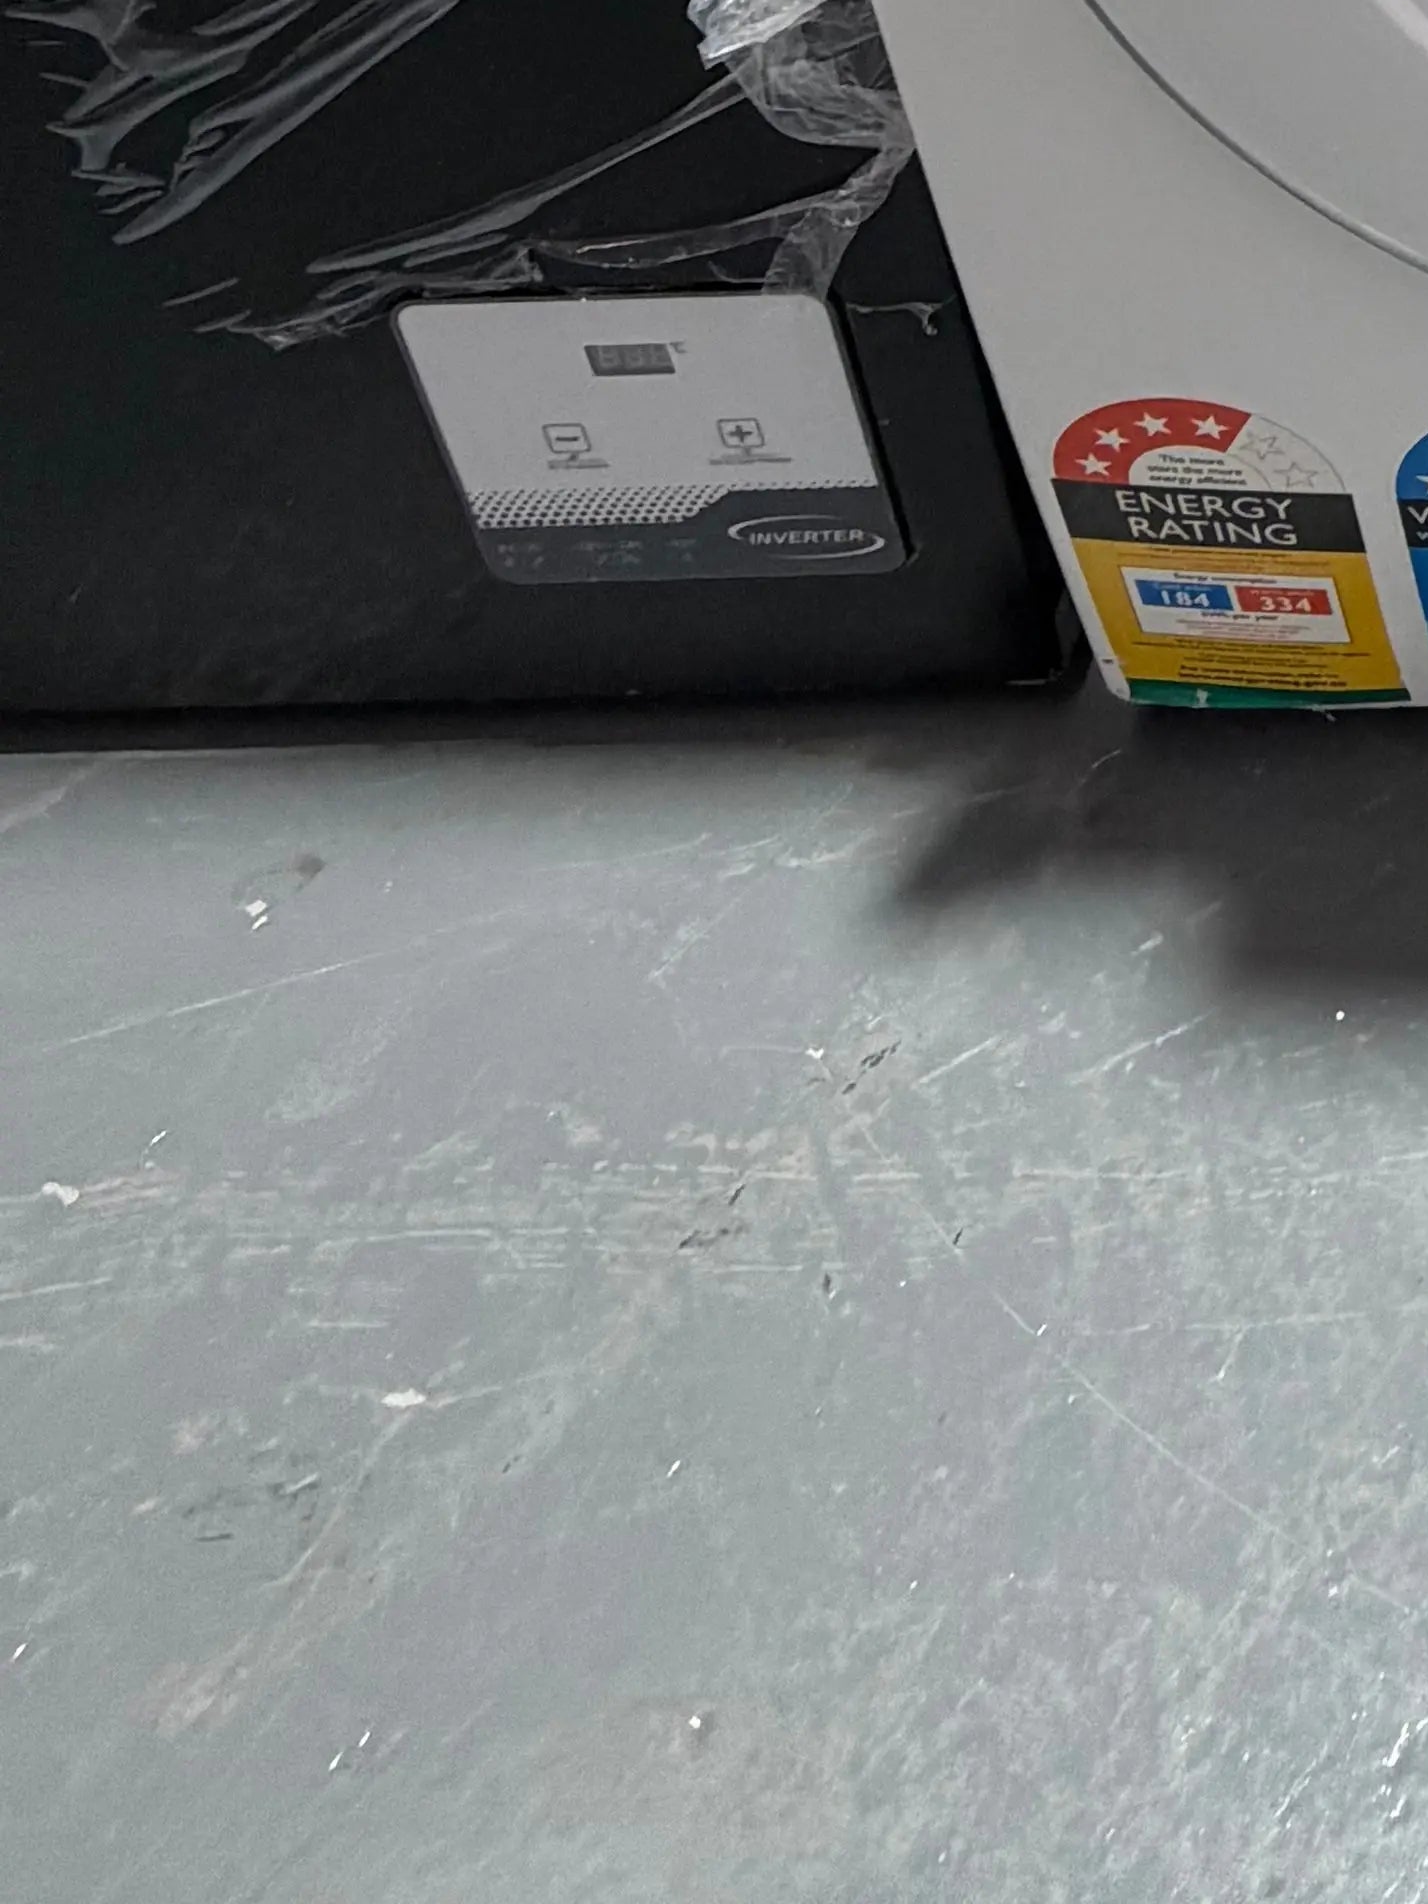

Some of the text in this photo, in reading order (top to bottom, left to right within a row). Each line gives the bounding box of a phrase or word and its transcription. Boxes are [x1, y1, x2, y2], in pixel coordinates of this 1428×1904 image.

[1114, 489, 1293, 520] ENERGY
[749, 528, 866, 546] INVERTER
[1127, 516, 1298, 545] RATING
[1160, 589, 1211, 608] 184
[1259, 595, 1313, 613] 334
